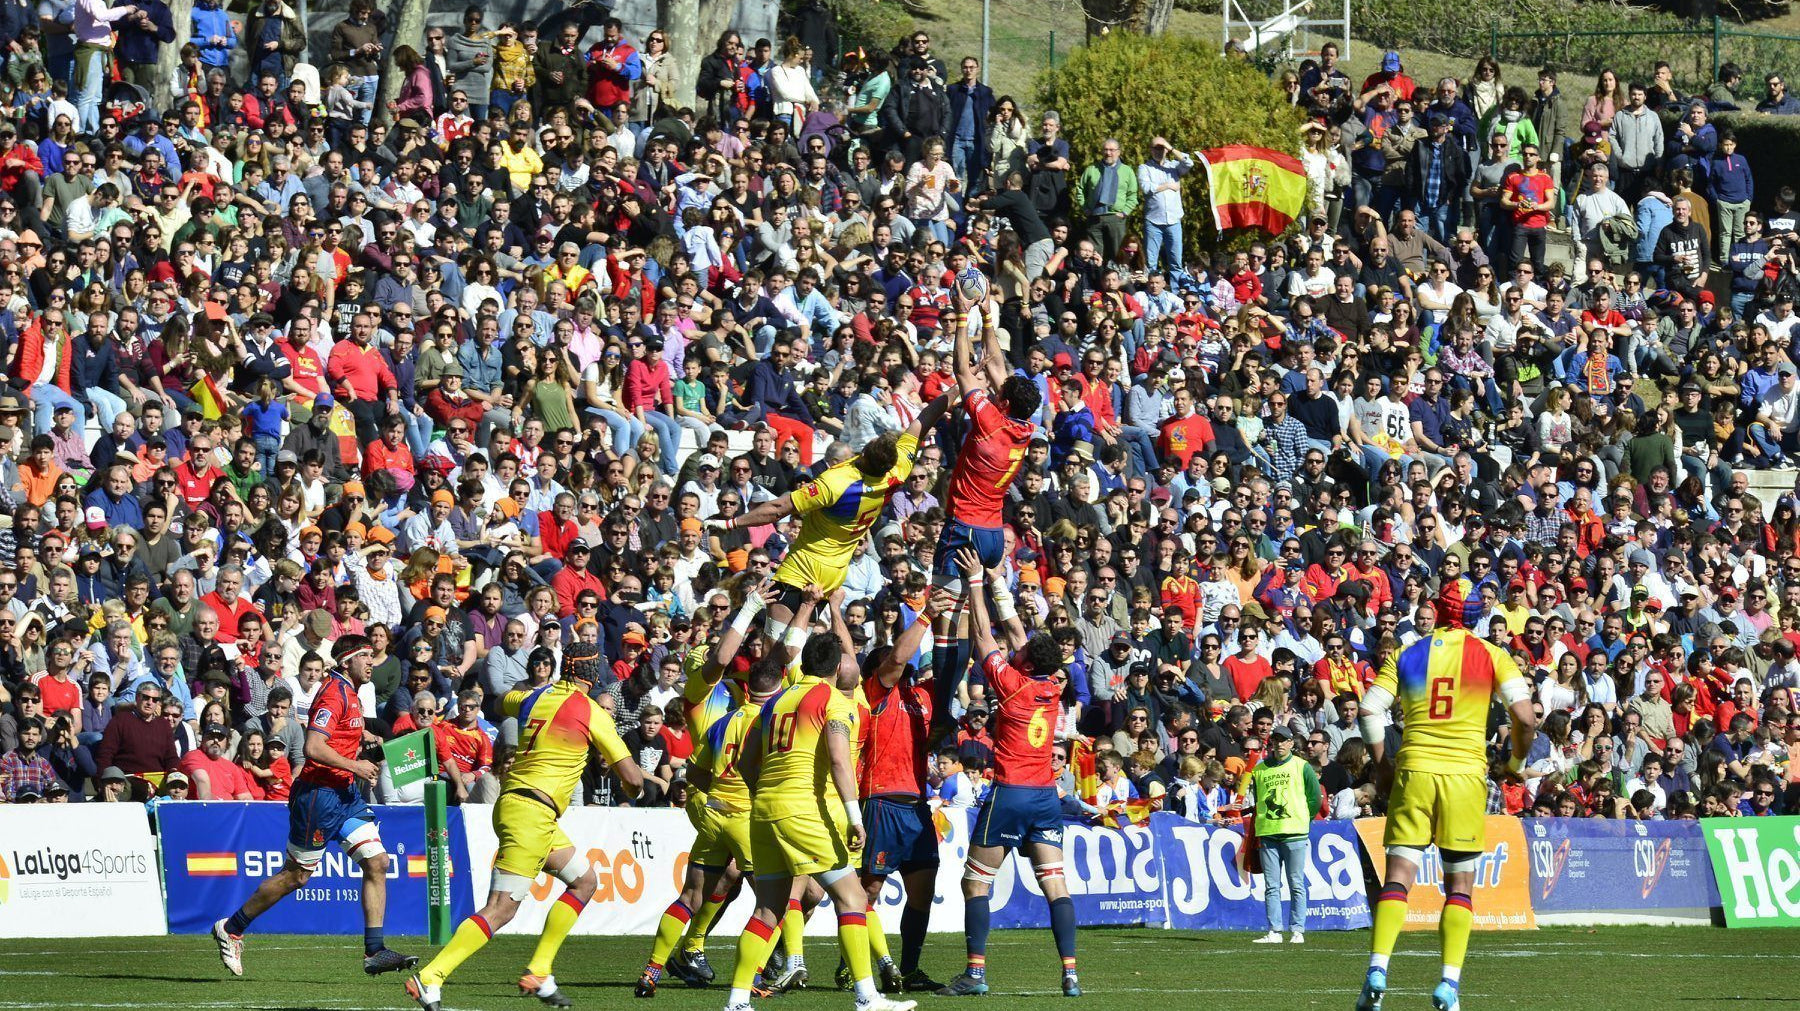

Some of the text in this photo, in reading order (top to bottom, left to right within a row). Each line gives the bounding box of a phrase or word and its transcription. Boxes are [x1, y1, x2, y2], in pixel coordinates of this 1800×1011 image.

[994, 447, 1028, 488] 7
[1429, 677, 1454, 720] 6
[522, 718, 548, 756] 7
[768, 712, 798, 754] 10
[1027, 706, 1049, 749] 6
[718, 743, 739, 778] 2
[631, 831, 654, 859] fit
[1533, 840, 1555, 878] CSD
[1634, 839, 1656, 878] CSD
[296, 888, 359, 902] DESDE 1933
[430, 846, 440, 906] Heineken
